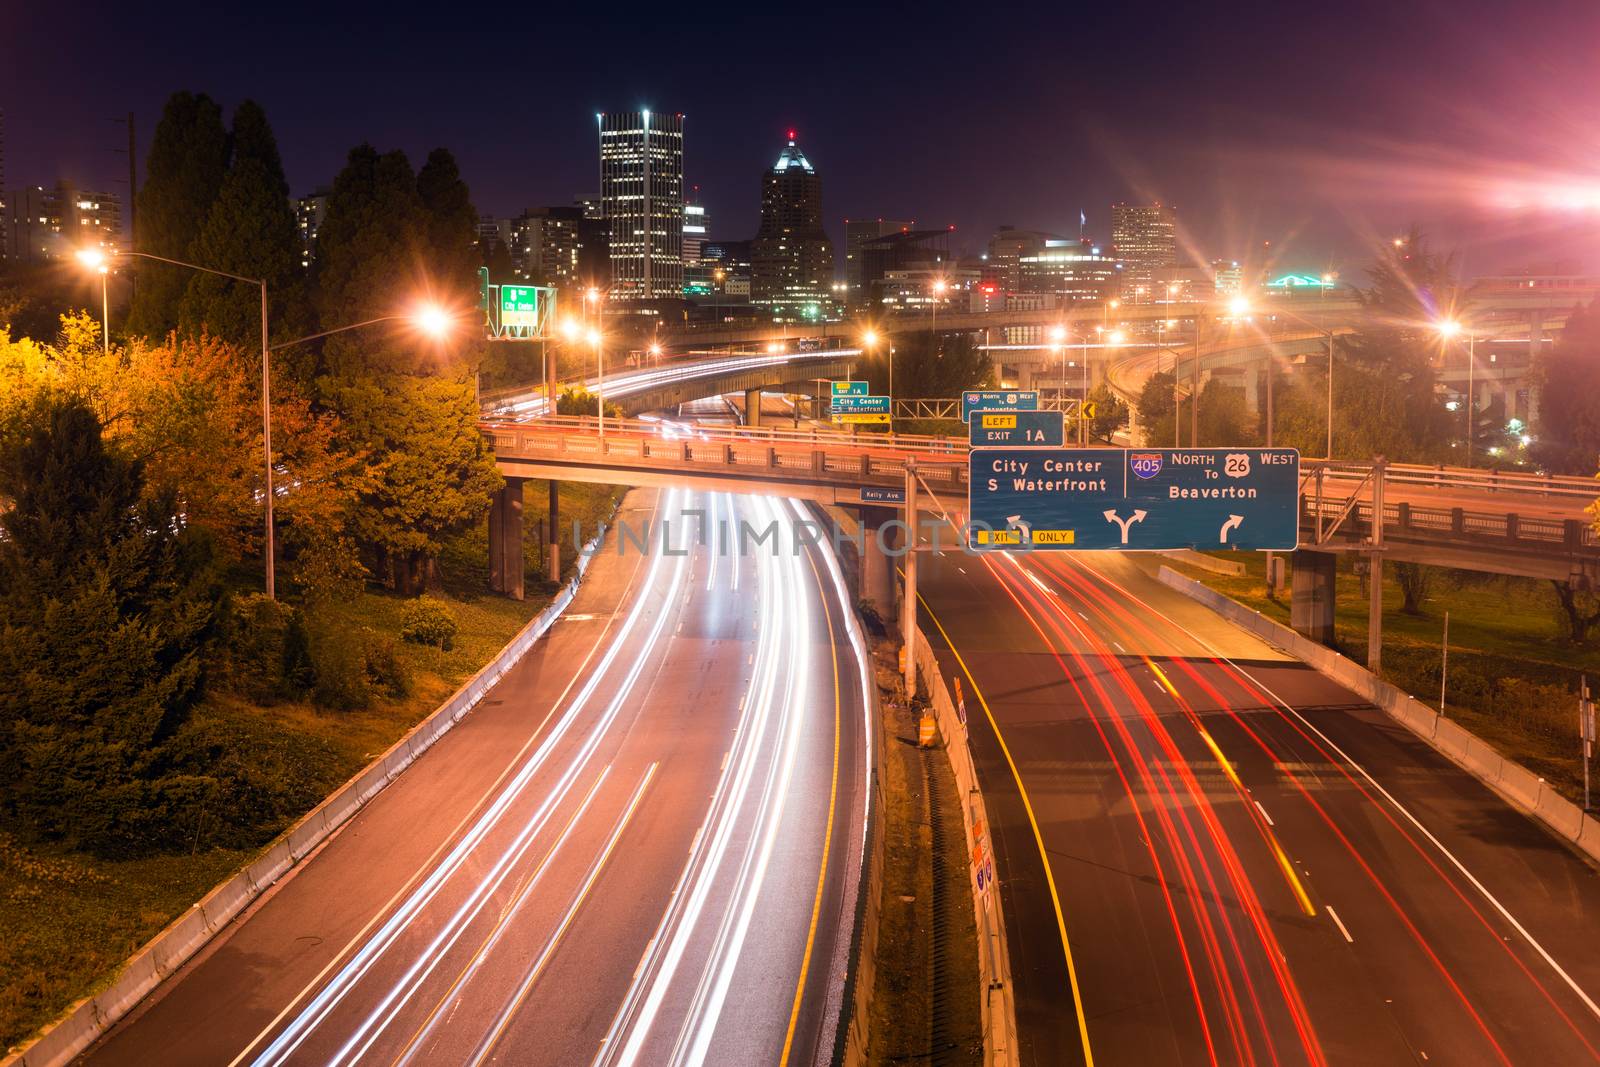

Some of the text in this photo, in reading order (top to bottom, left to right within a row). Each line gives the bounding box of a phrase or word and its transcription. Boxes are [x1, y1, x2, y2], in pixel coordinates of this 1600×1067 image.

[986, 417, 1013, 426] LEFT
[987, 430, 1045, 441] EXIT 1A
[992, 459, 1102, 475] City Center
[1134, 460, 1160, 472] 405
[1228, 459, 1248, 472] 26
[988, 478, 1106, 491] S Waterfront
[866, 491, 883, 499] Kelly
[1169, 486, 1257, 499] Beaverton
[1039, 532, 1068, 542] ONLY
